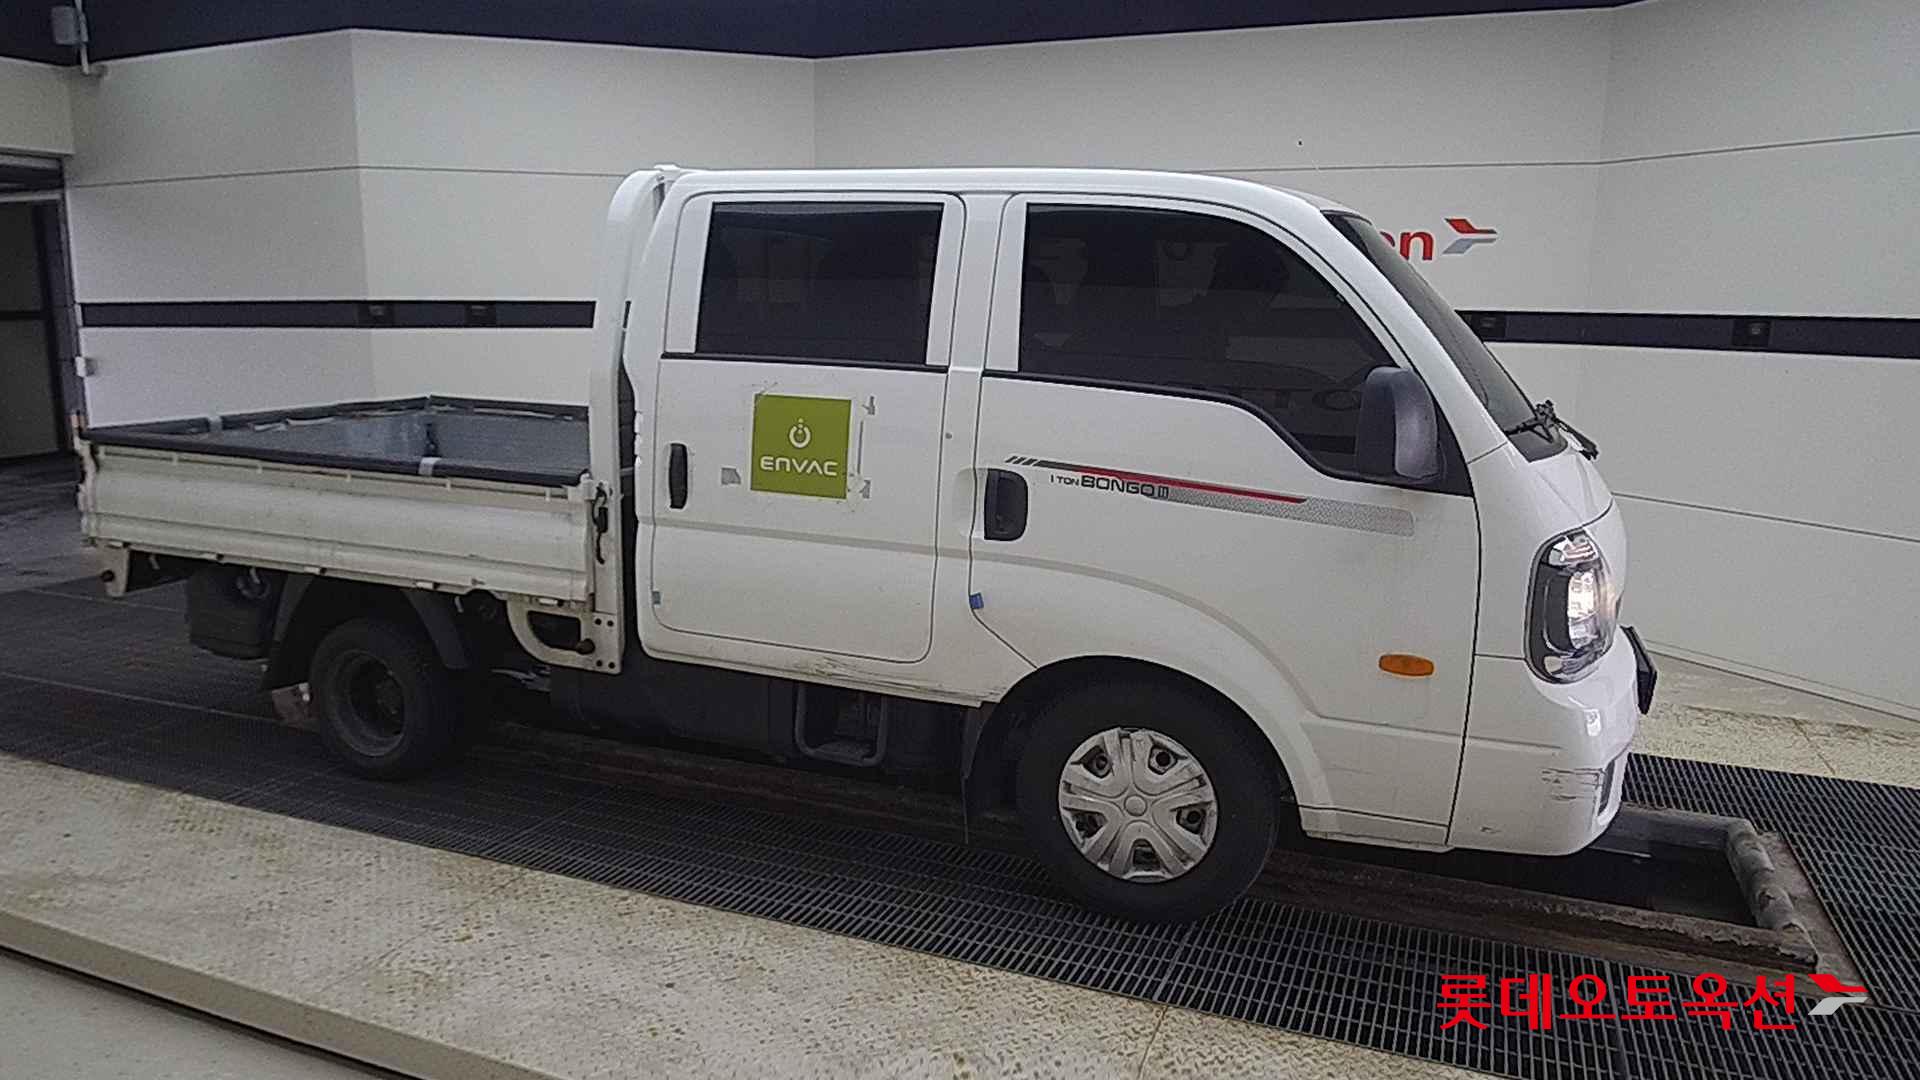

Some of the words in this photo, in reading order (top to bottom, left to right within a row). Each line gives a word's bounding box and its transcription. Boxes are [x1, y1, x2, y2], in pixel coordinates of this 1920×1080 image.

[760, 455, 838, 476] ENVAC
[1056, 475, 1080, 486] TON
[1080, 474, 1155, 497] BONGO
